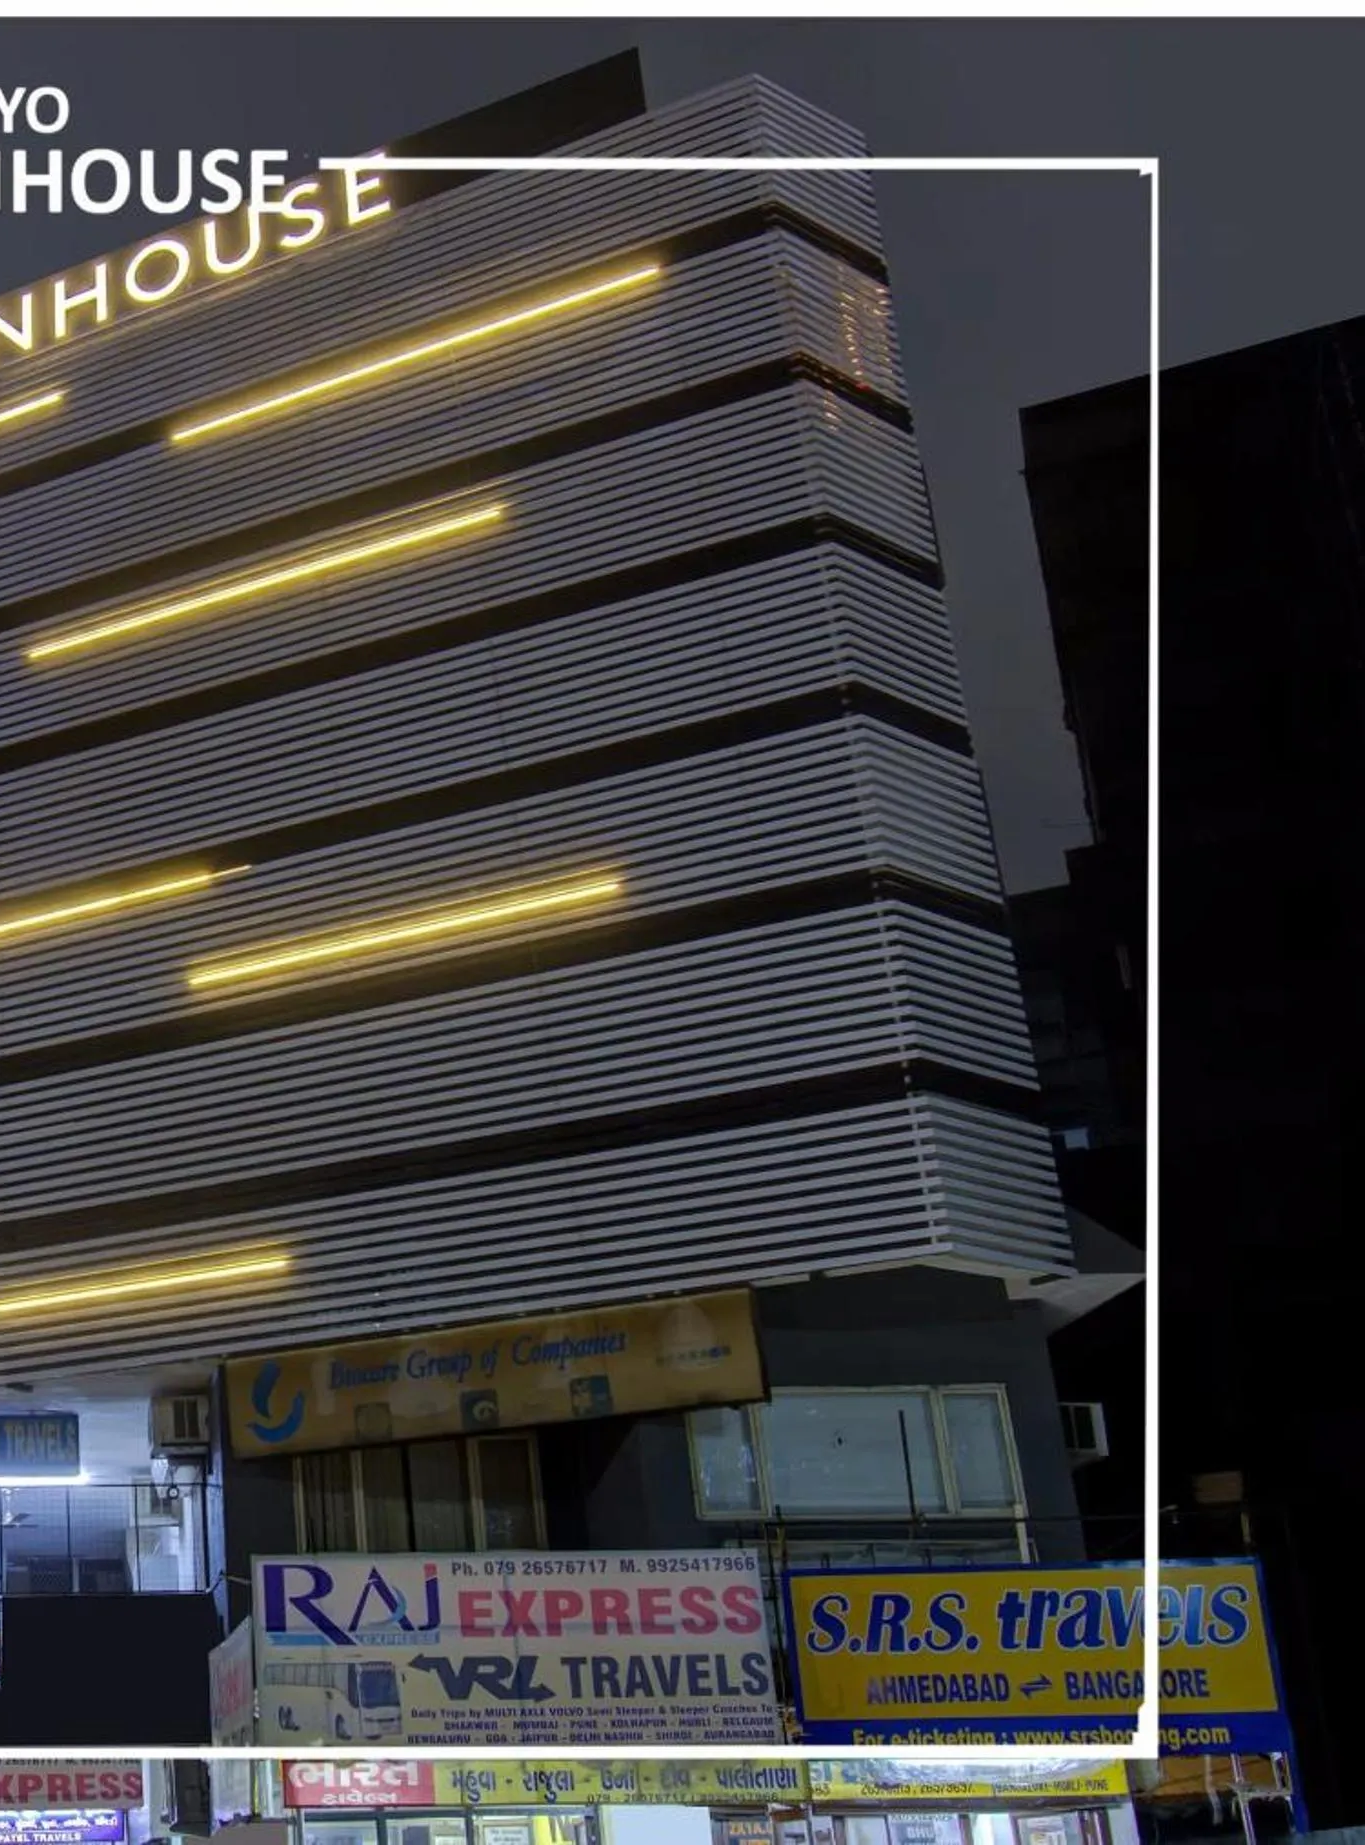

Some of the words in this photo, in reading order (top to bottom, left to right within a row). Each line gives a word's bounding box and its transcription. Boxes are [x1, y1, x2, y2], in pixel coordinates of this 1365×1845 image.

[405, 1349, 472, 1384] Group
[479, 1341, 503, 1379] of
[510, 1331, 628, 1370] Companies
[451, 1560, 479, 1576] Ph.
[485, 1560, 516, 1576] 079
[522, 1559, 607, 1575] 26576717
[620, 1558, 641, 1574] M.
[647, 1556, 756, 1573] 9925417966
[262, 1563, 441, 1646] RAJ
[457, 1584, 762, 1638] EXPRESS
[805, 1590, 982, 1656] S.R.S.
[996, 1583, 1251, 1653] travels
[432, 1654, 557, 1702] VRL
[560, 1652, 770, 1700] TRAVELS
[866, 1671, 1010, 1706] AHMEDABAD
[1063, 1667, 1211, 1701] BANGAORE
[549, 1705, 584, 1717] VOLVO
[31, 1832, 82, 1843] TRAVELS
